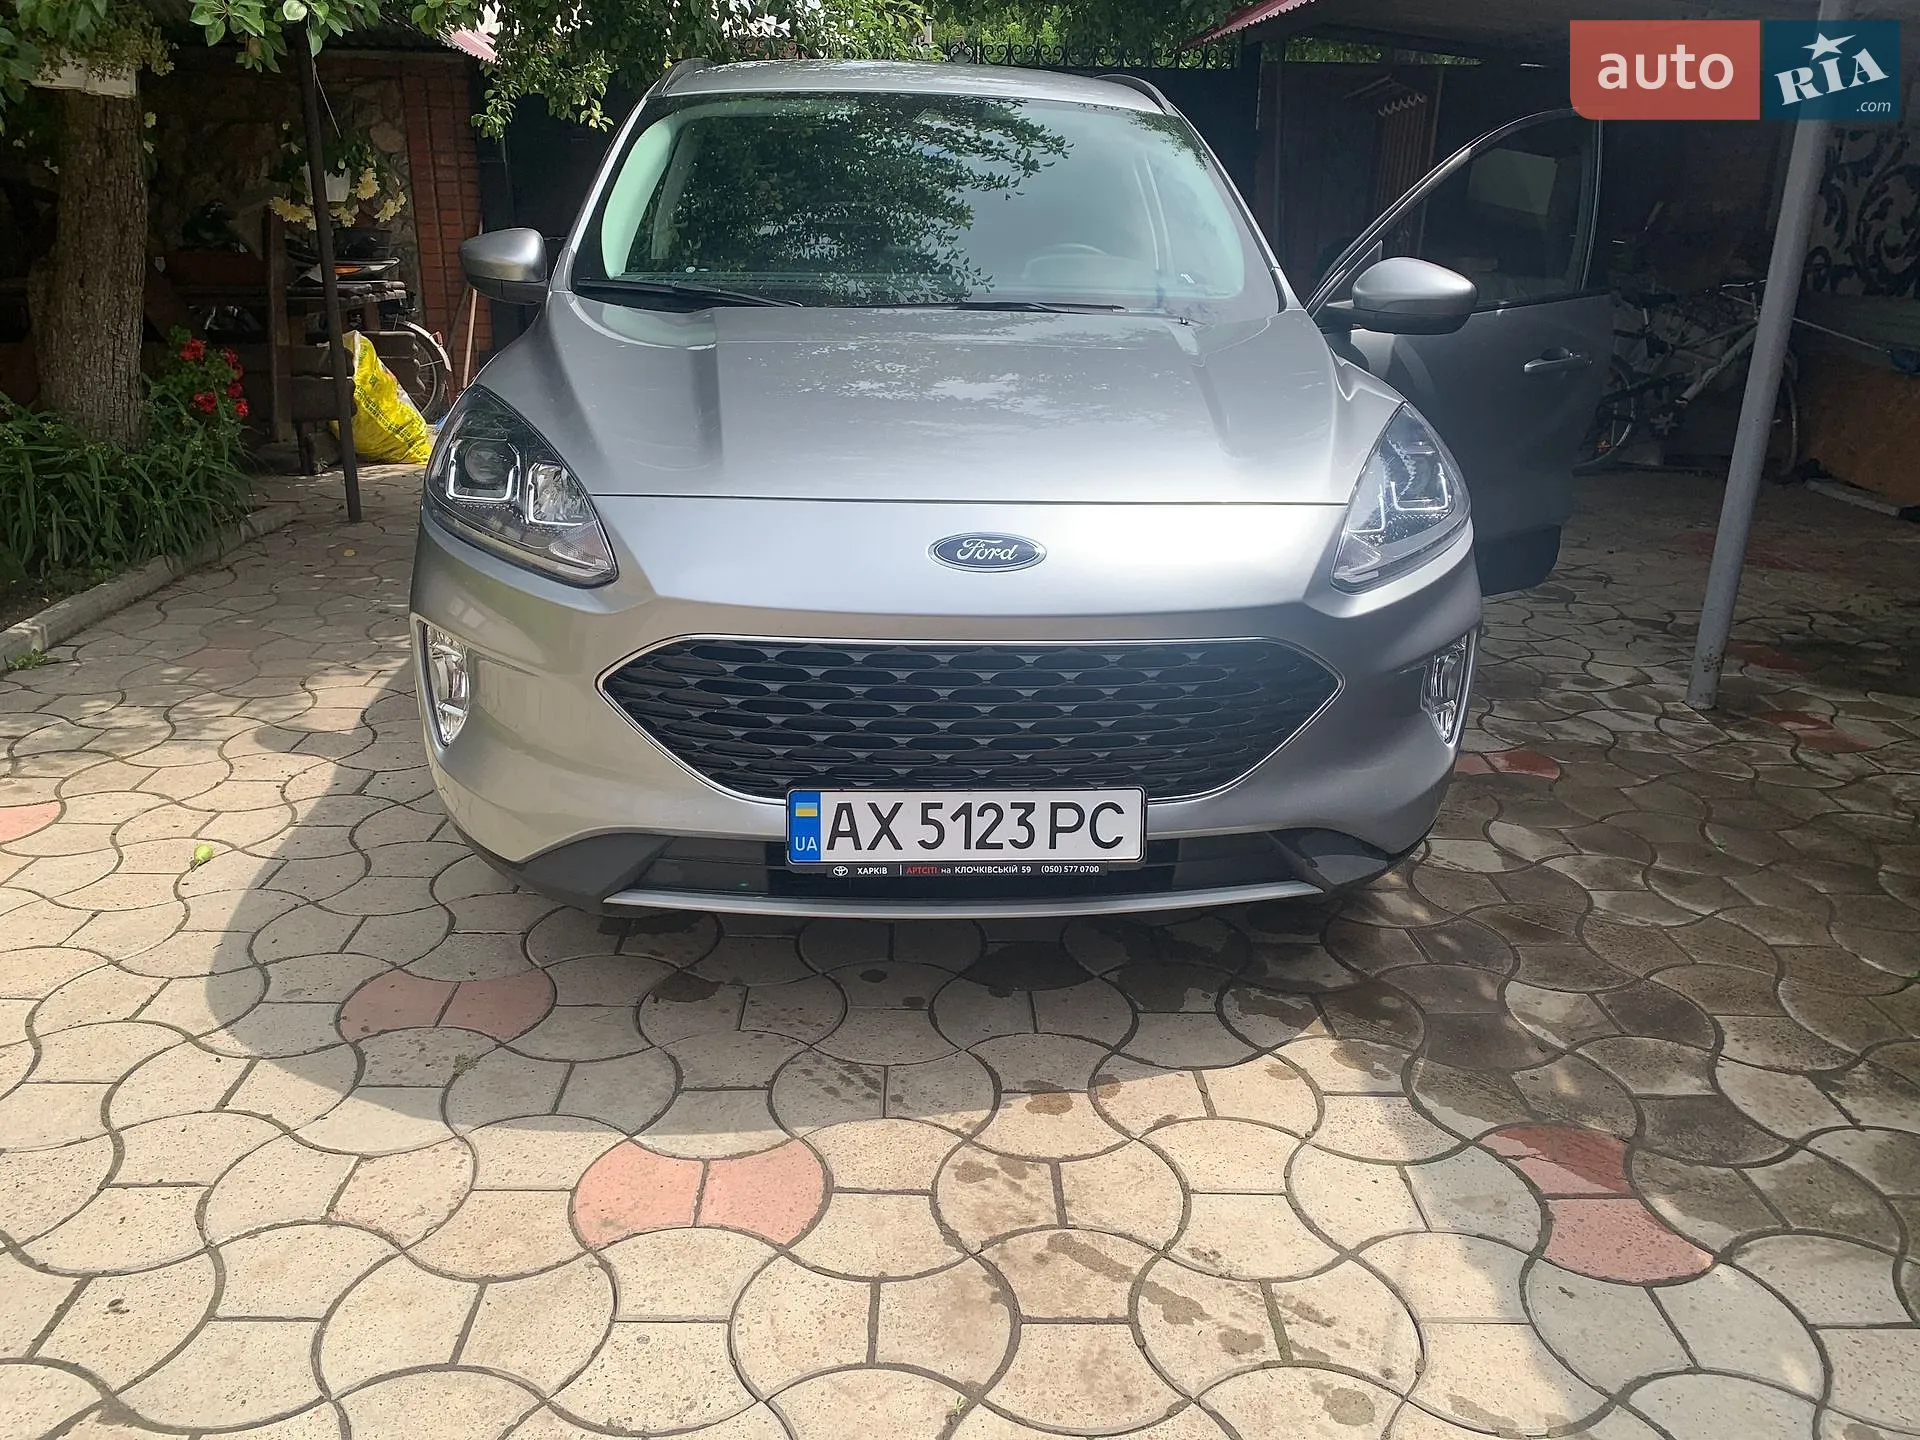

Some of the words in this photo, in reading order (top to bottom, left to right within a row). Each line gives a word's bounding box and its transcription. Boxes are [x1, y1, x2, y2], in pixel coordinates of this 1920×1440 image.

[957, 538, 1018, 560] Ford
[826, 802, 903, 850] AX
[917, 802, 1036, 850] 5123
[1049, 802, 1124, 850] PC
[795, 836, 818, 851] UA
[857, 867, 888, 875] ХАРКІВ
[954, 864, 1018, 874] КЛОЧКІВСЬКІЙ
[1041, 865, 1062, 874] (050)
[1064, 865, 1078, 873] 577
[1080, 865, 1100, 873] 0700
